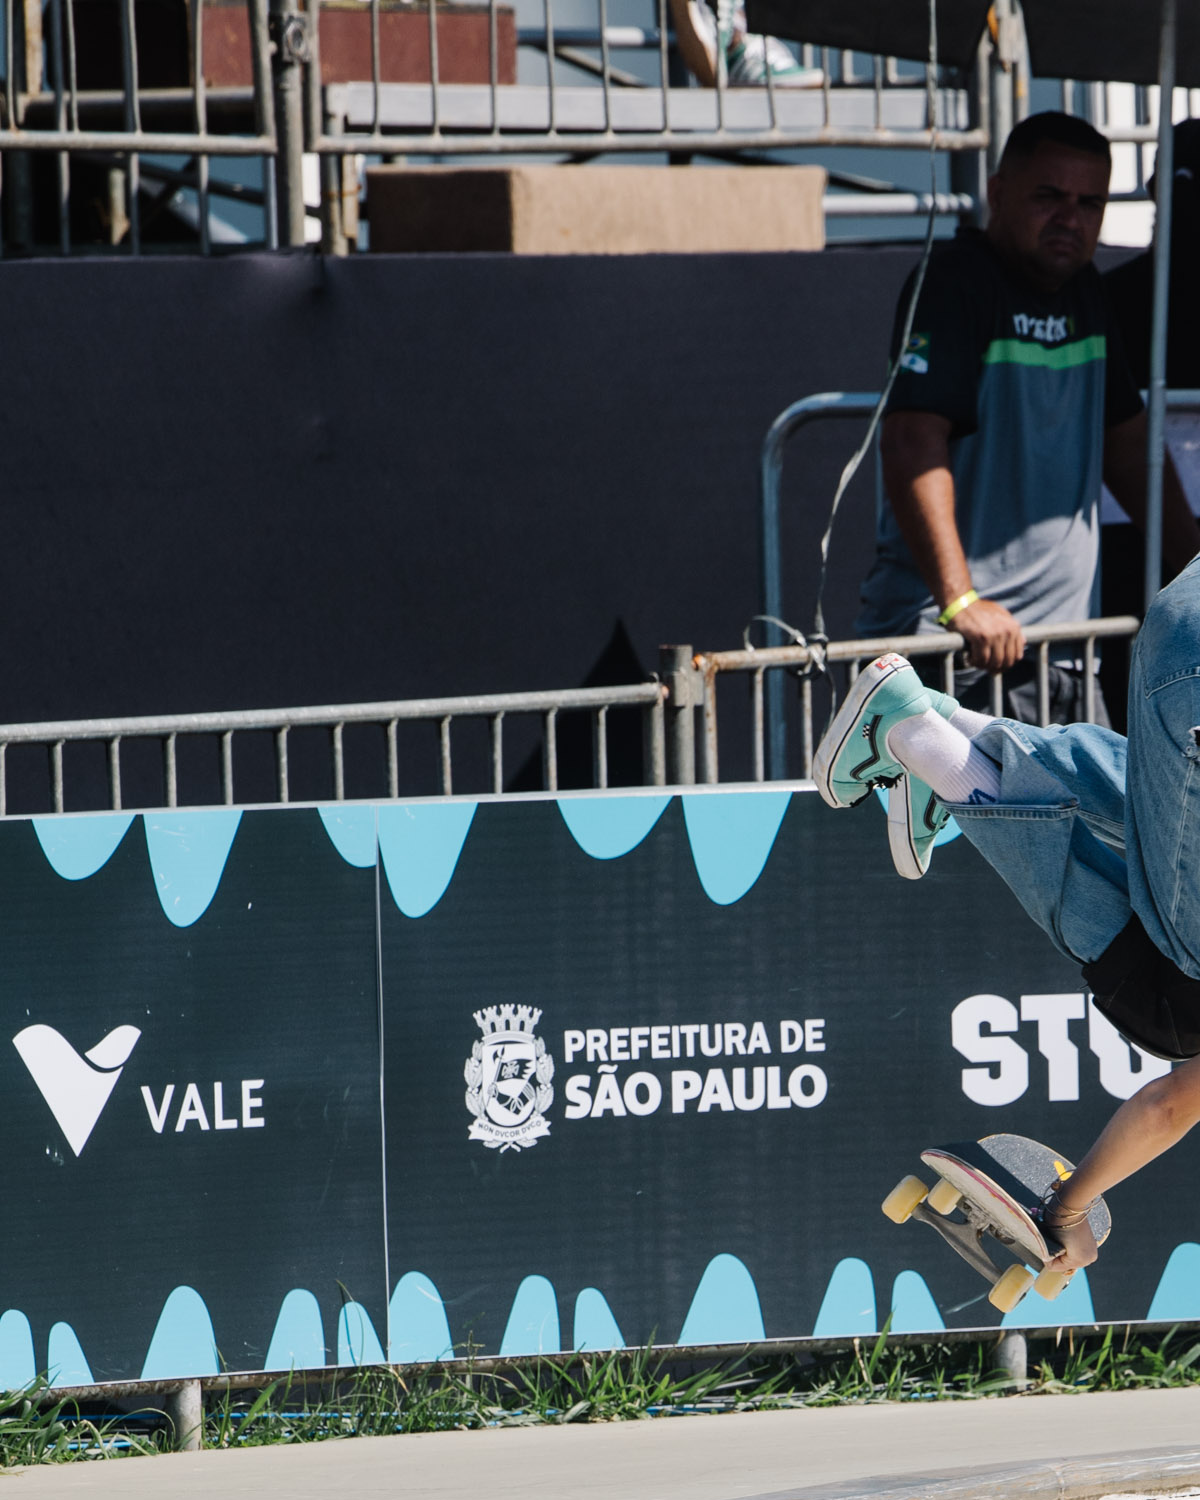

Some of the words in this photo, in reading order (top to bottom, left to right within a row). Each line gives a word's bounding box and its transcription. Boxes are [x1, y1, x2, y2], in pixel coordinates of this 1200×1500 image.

[565, 1022, 771, 1062] PREFEITURA
[780, 1019, 826, 1053] DE
[952, 993, 1172, 1106] STU
[141, 1079, 265, 1133] VALE
[565, 1064, 662, 1119] SÃO
[672, 1063, 828, 1113] PAULO
[478, 1122, 494, 1133] NON
